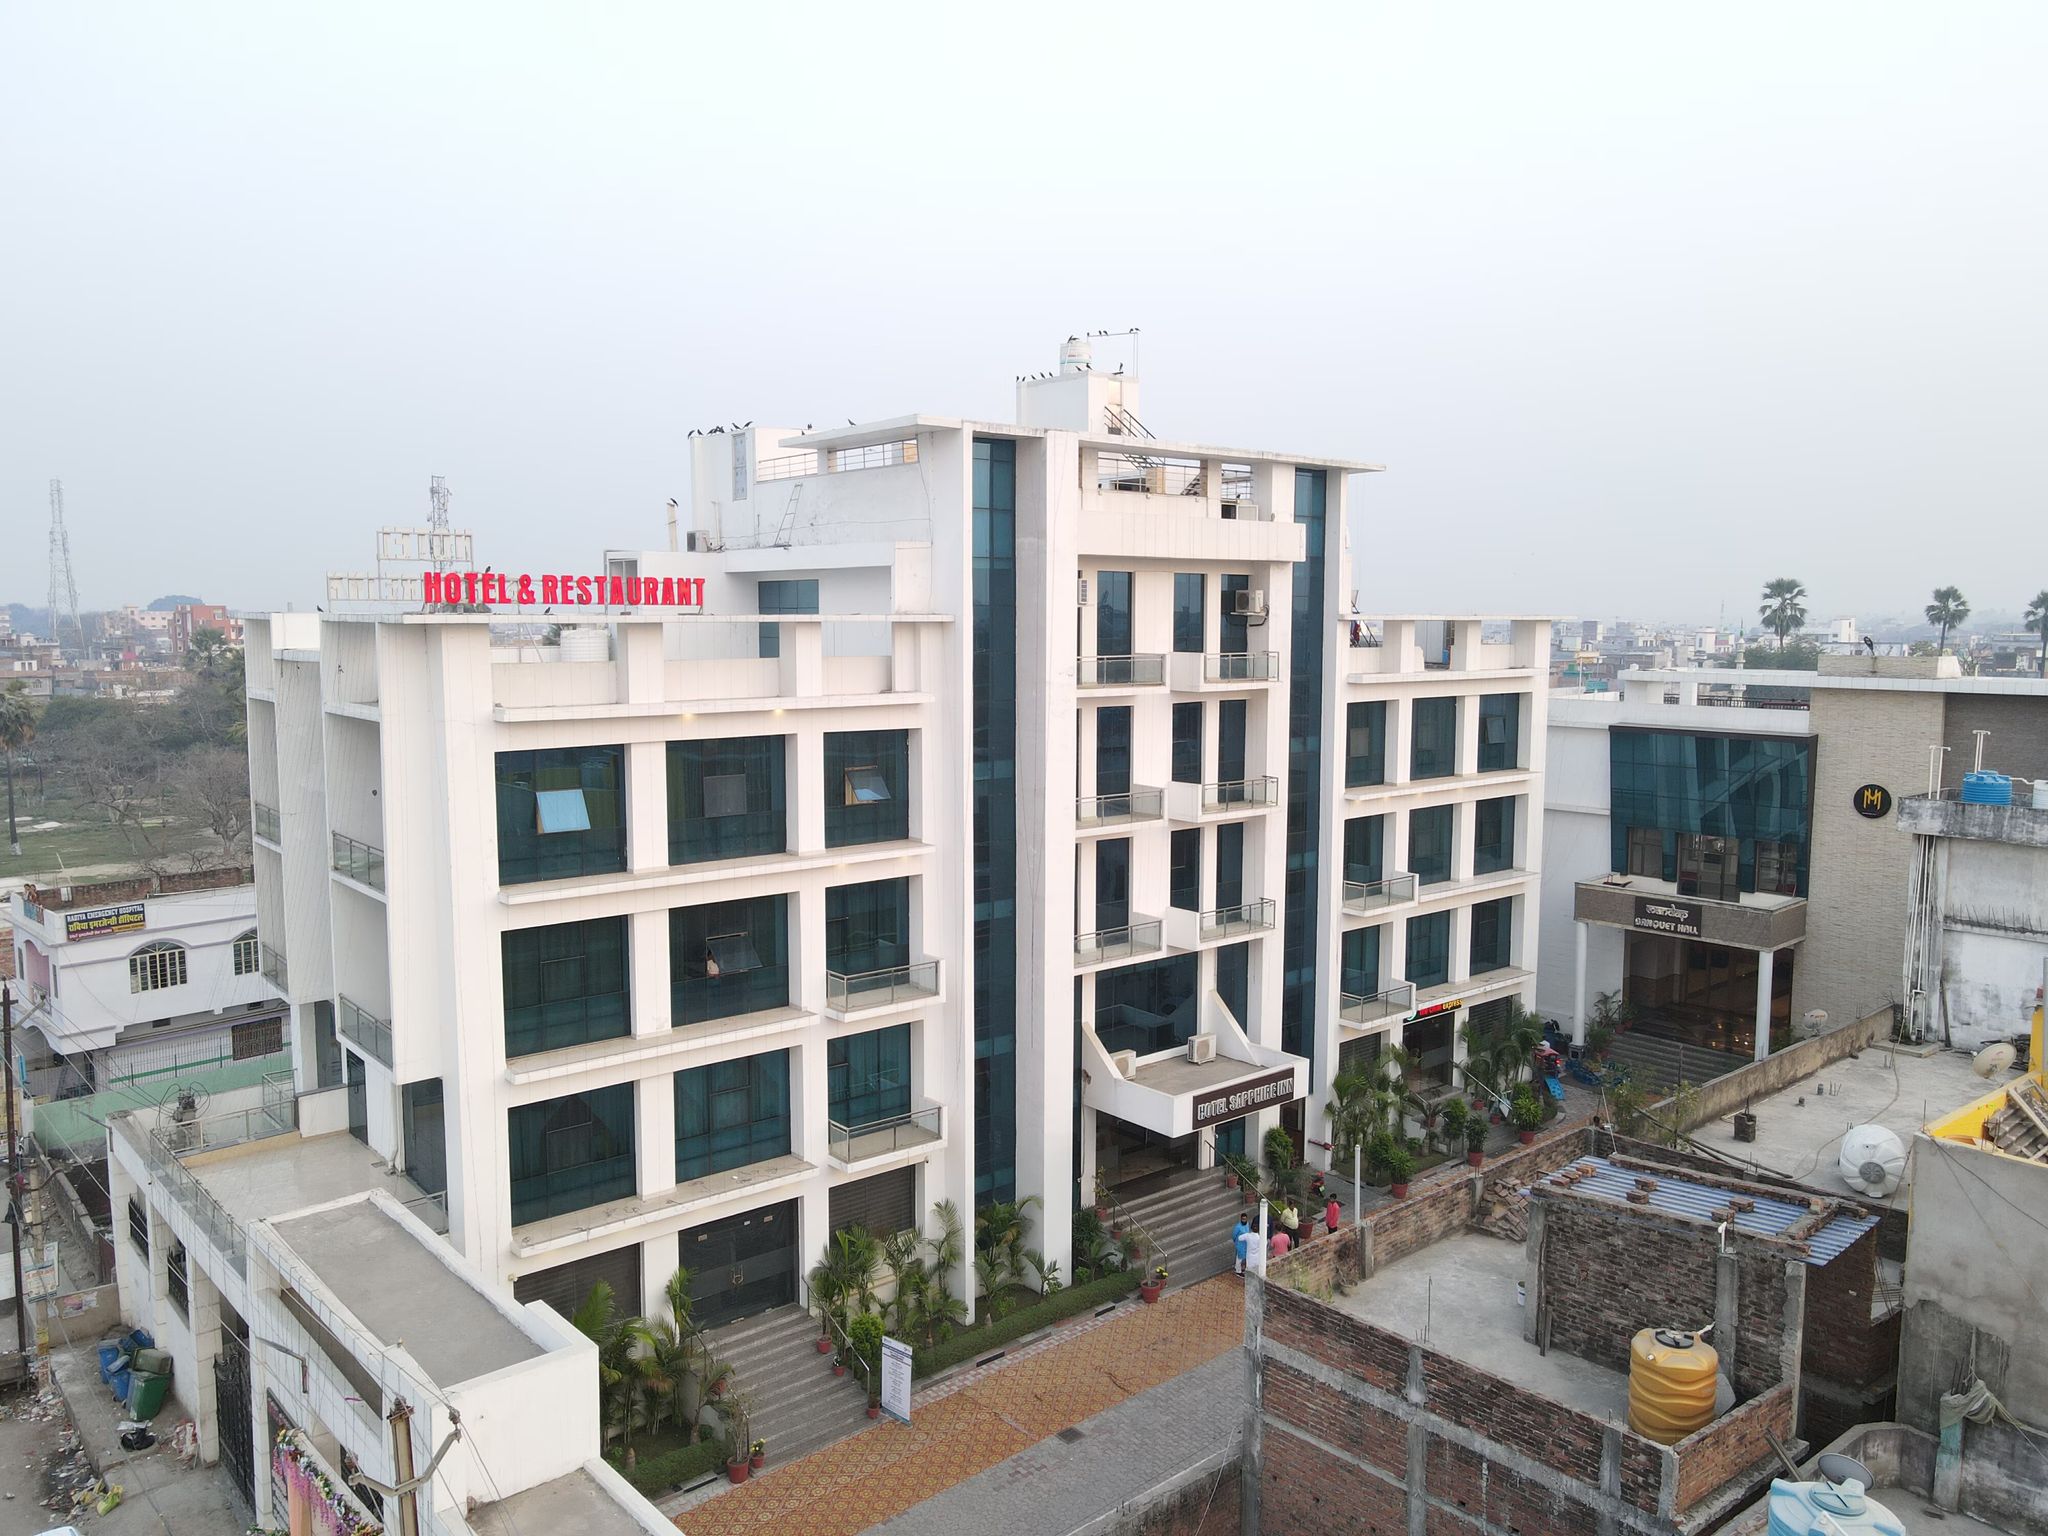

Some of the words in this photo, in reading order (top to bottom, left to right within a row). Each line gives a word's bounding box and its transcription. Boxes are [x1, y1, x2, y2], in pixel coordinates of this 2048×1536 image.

[424, 571, 511, 605] HOTEL
[517, 574, 536, 604] &
[542, 574, 706, 606] RESTAURANT
[86, 908, 118, 919] EMERGENCY
[119, 905, 144, 914] HOSPITAL
[1635, 917, 1676, 931] BANQUET
[1677, 923, 1699, 935] HALL
[1197, 1097, 1229, 1121] HOTEL
[1229, 1082, 1277, 1111] SAPPHIRE
[1277, 1078, 1293, 1096] INN
